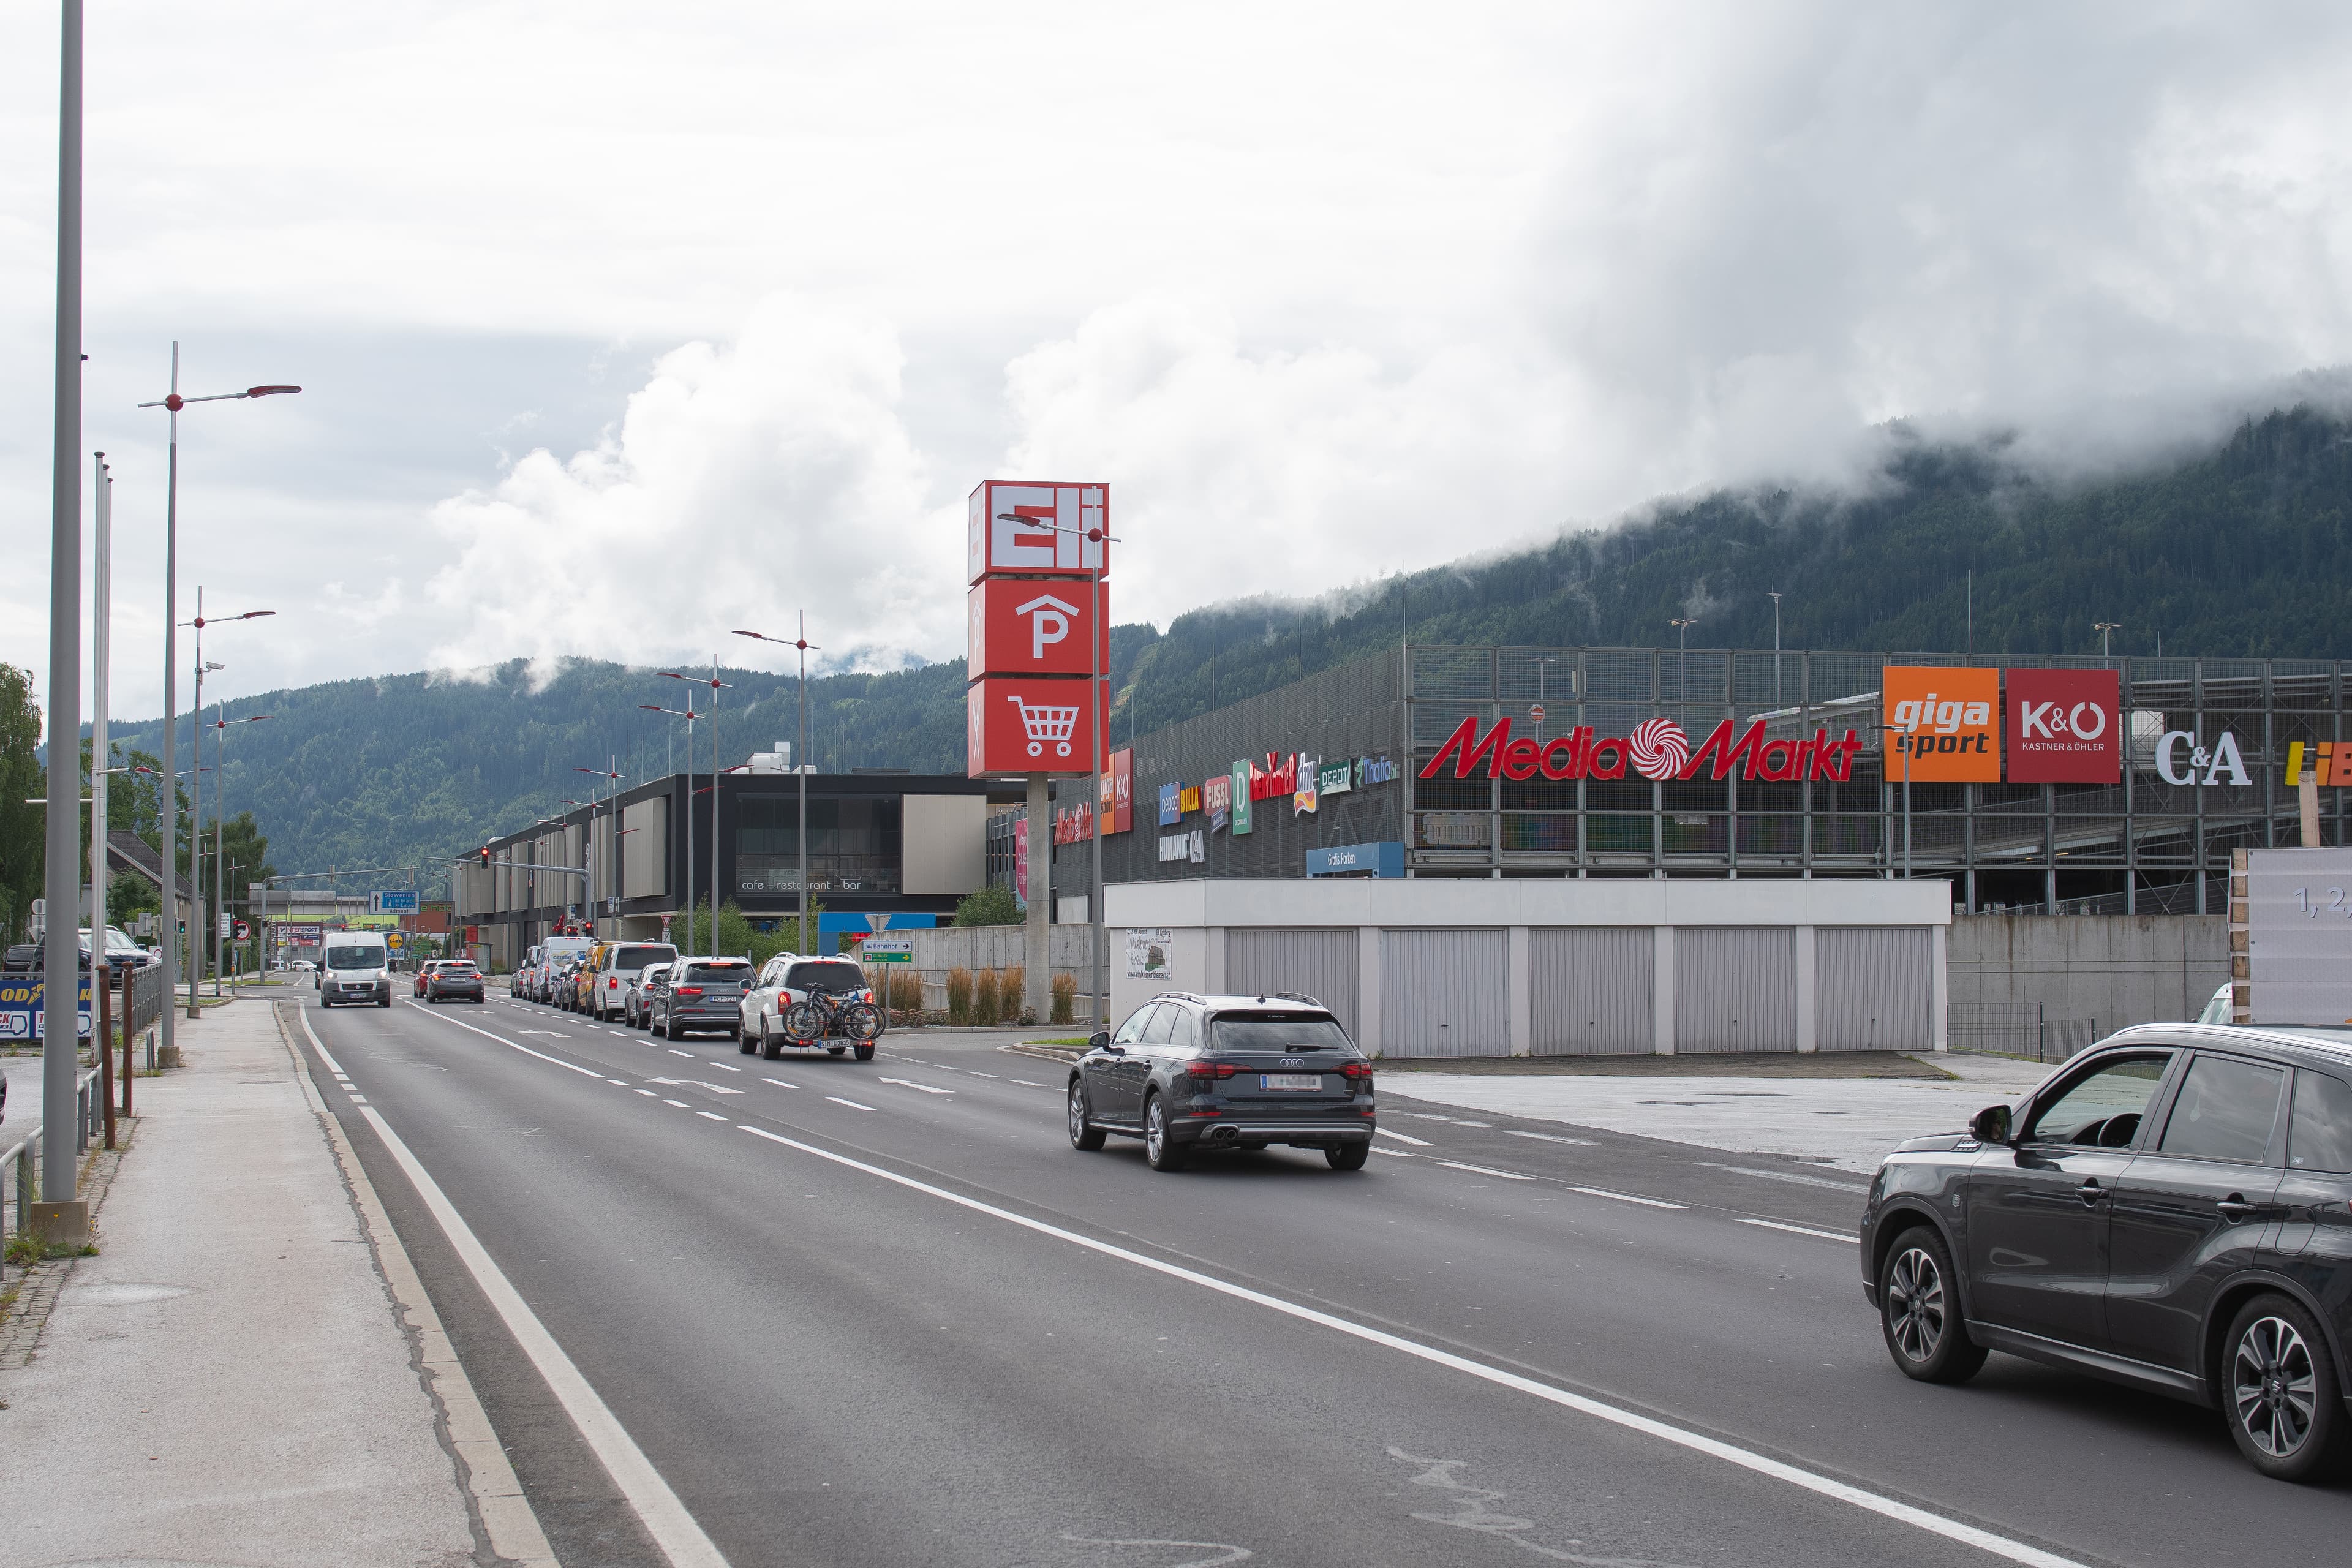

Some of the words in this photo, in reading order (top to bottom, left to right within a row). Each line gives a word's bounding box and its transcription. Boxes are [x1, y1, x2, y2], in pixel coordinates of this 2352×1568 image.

[1893, 693, 1990, 733] giga
[1895, 733, 1990, 759] sport
[2022, 742, 2065, 752] KASTNER
[2075, 741, 2105, 752] ÖHLER
[2155, 731, 2252, 785] C&A
[1297, 752, 1315, 792] dm
[1322, 767, 1348, 786] DEPOT
[1161, 796, 1178, 816] pepco
[1181, 786, 1199, 813] BILLA
[1207, 783, 1229, 809] FUSSL
[1159, 833, 1189, 862] HUMANIC
[1328, 853, 1340, 865] Gratis
[742, 880, 764, 889] cafe
[843, 880, 861, 889] bar
